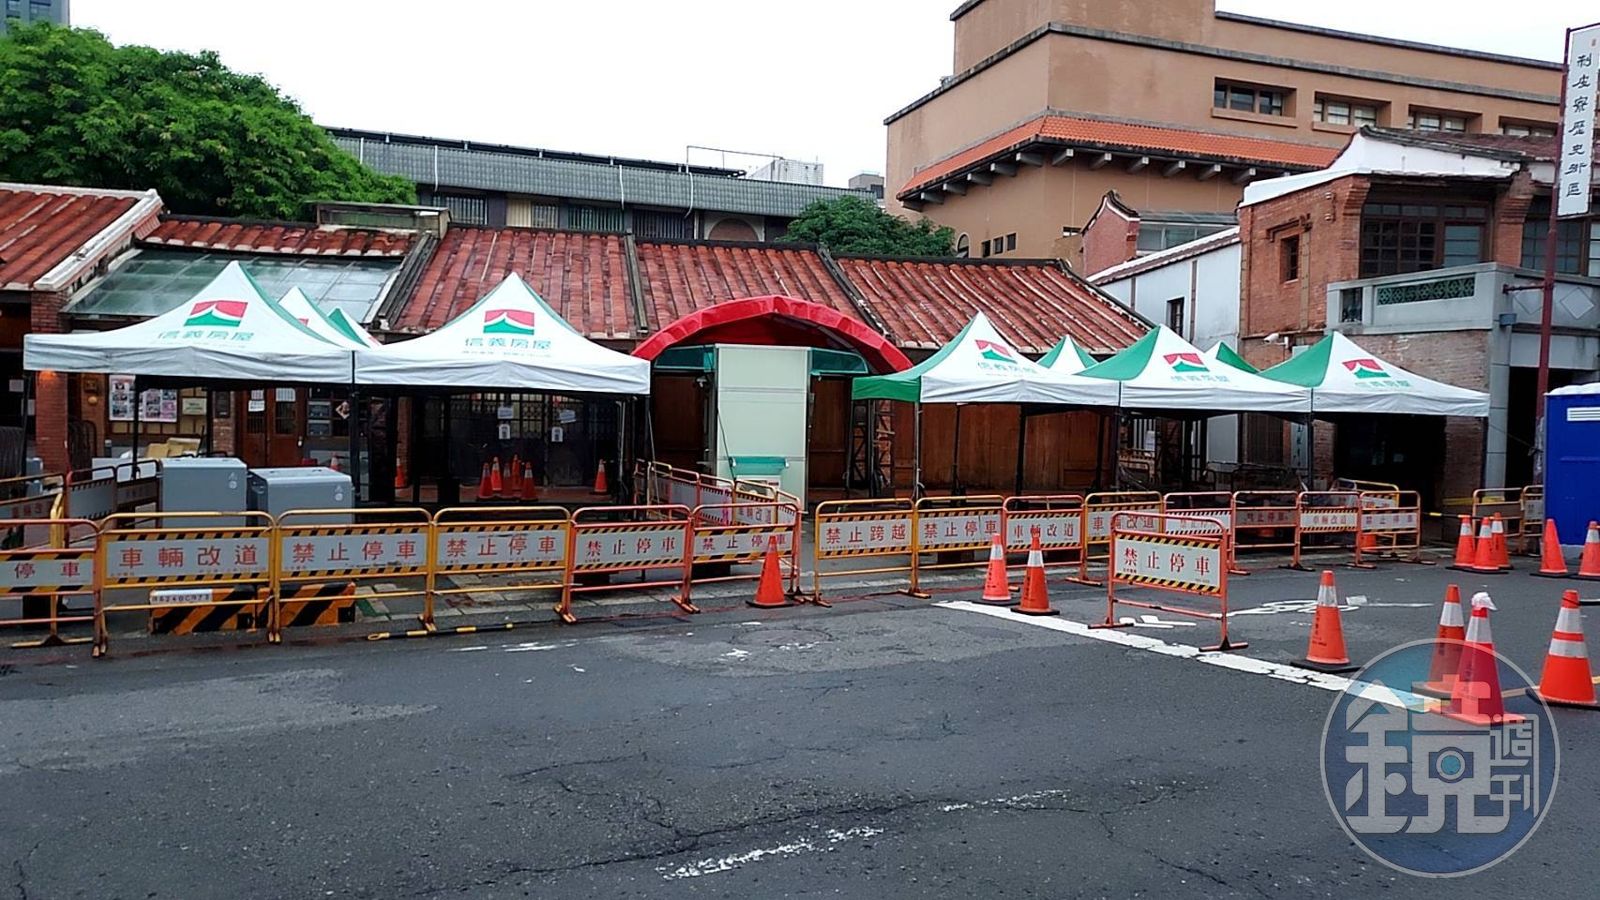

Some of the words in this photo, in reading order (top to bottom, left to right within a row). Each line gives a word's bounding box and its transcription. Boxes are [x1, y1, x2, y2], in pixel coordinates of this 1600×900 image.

[158, 330, 254, 341] 信義房屋
[465, 337, 551, 349] 信義房屋
[826, 523, 906, 545] 禁止跨越
[924, 520, 998, 539] 禁止停車
[119, 544, 258, 569] 車輛改道
[292, 540, 417, 564] 禁止停車
[447, 534, 556, 558] 禁止停車
[587, 536, 675, 557] 禁止停車
[14, 561, 81, 579] 停車
[1125, 547, 1210, 576] 禁止停車
